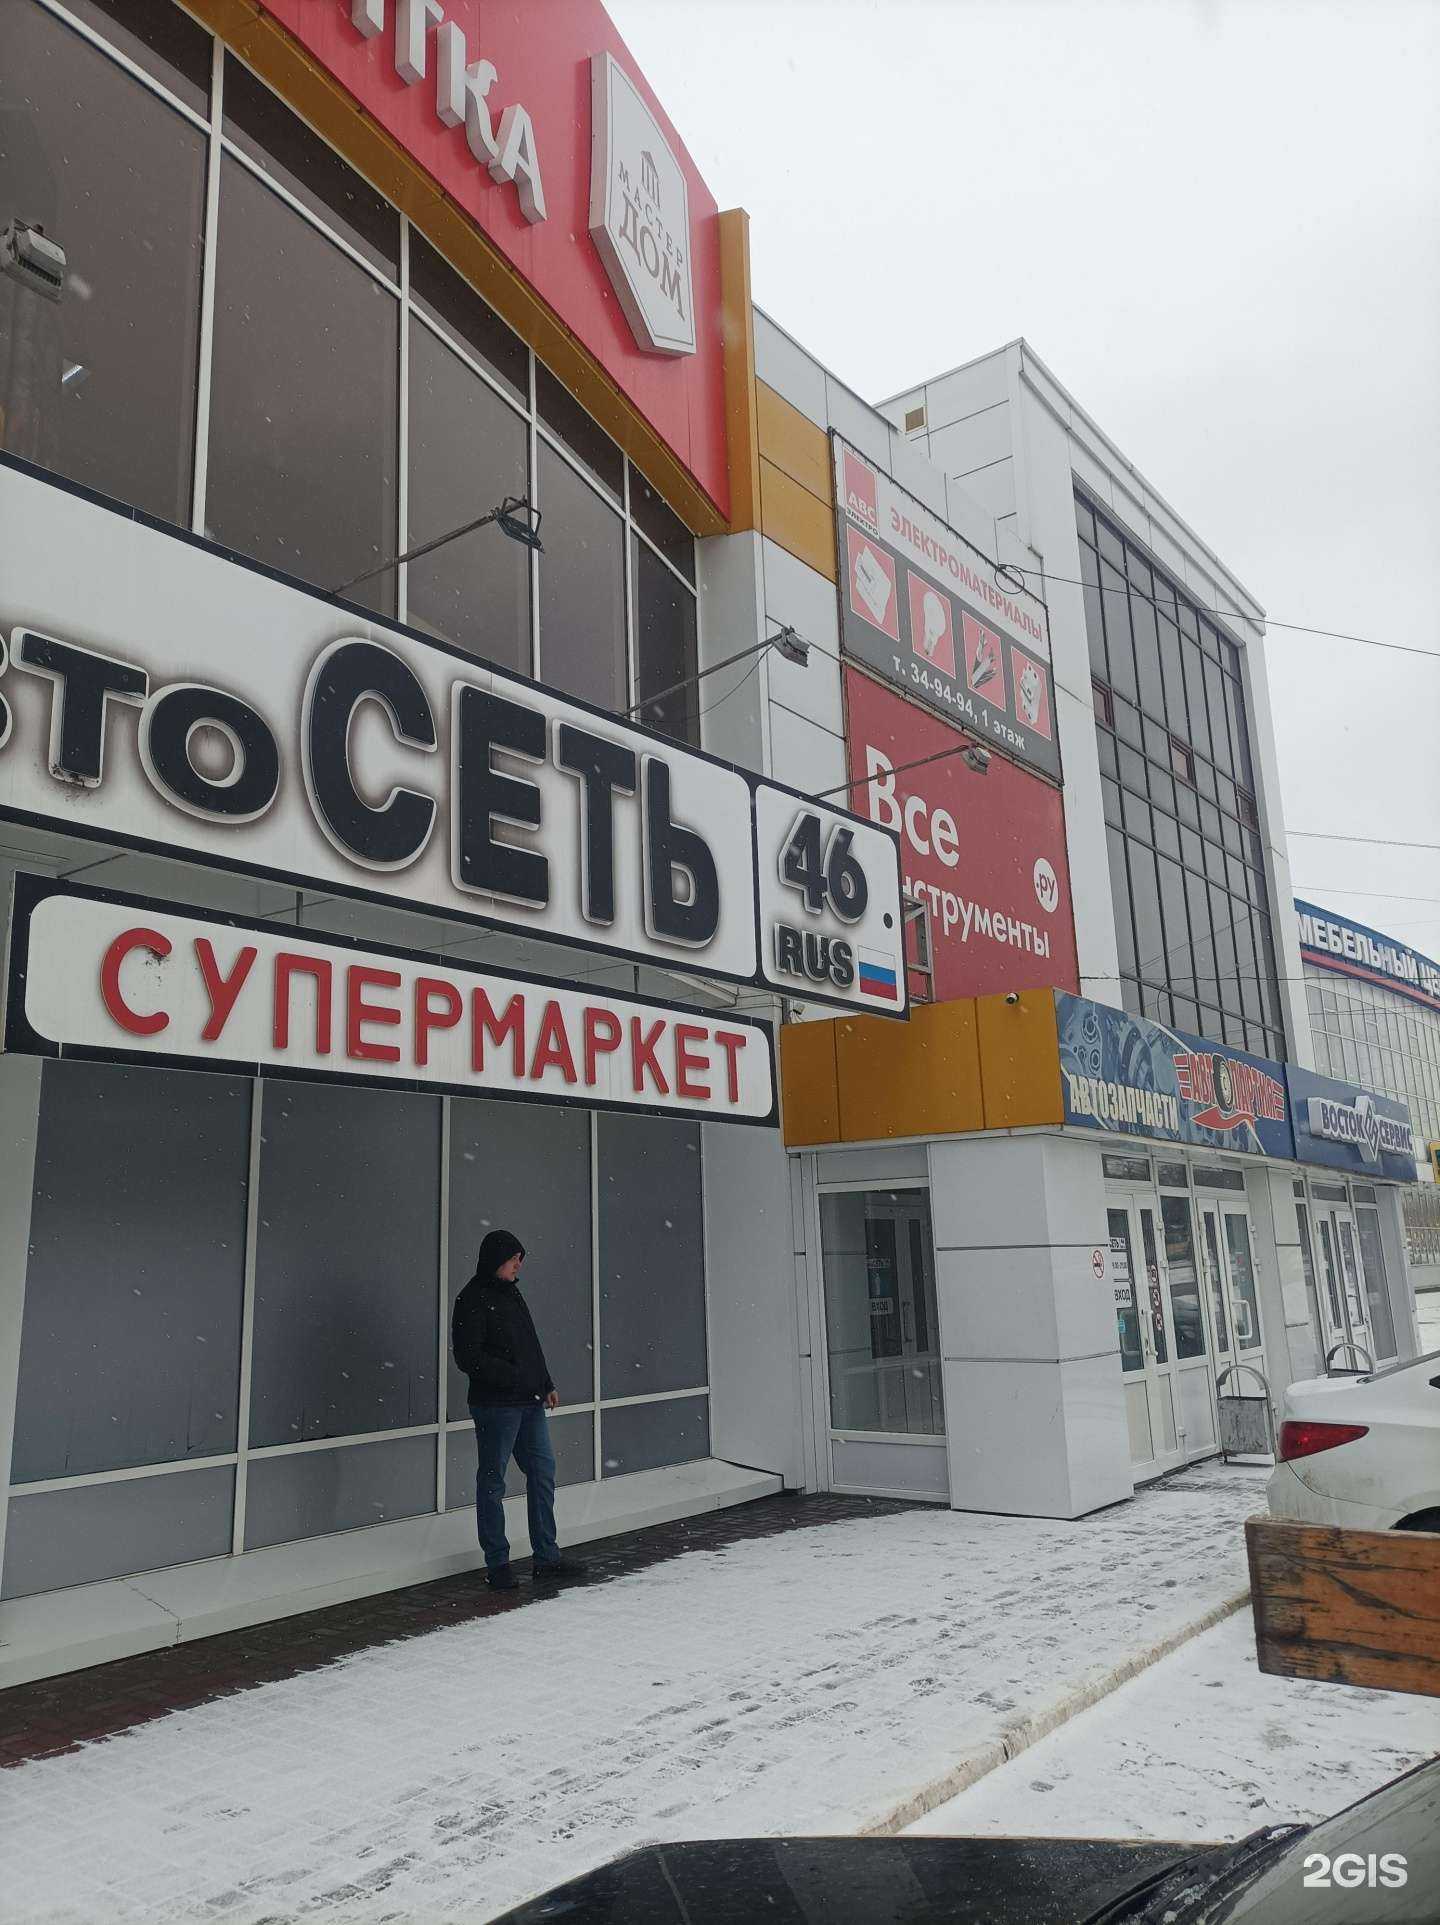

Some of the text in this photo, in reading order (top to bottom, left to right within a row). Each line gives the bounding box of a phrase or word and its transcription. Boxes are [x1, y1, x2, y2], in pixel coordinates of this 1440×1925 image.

[619, 160, 684, 268] МАСТЕР
[619, 190, 686, 322] ДОМ
[889, 506, 1043, 643] ЭЛЕКТРОМАТЕРИАЛЫ
[910, 662, 978, 724] 34-94-94,
[981, 709, 989, 727] 1
[993, 720, 1026, 751] этаж
[866, 744, 960, 867] Все
[777, 810, 869, 924] 46
[774, 921, 855, 989] RUS
[99, 927, 748, 1104] СУПЕРМАРКЕТ
[1069, 1073, 1180, 1132] АВТОЗАПЧАСТИ
[1320, 1102, 1413, 1151] ВОСТОК СЕРВИС
